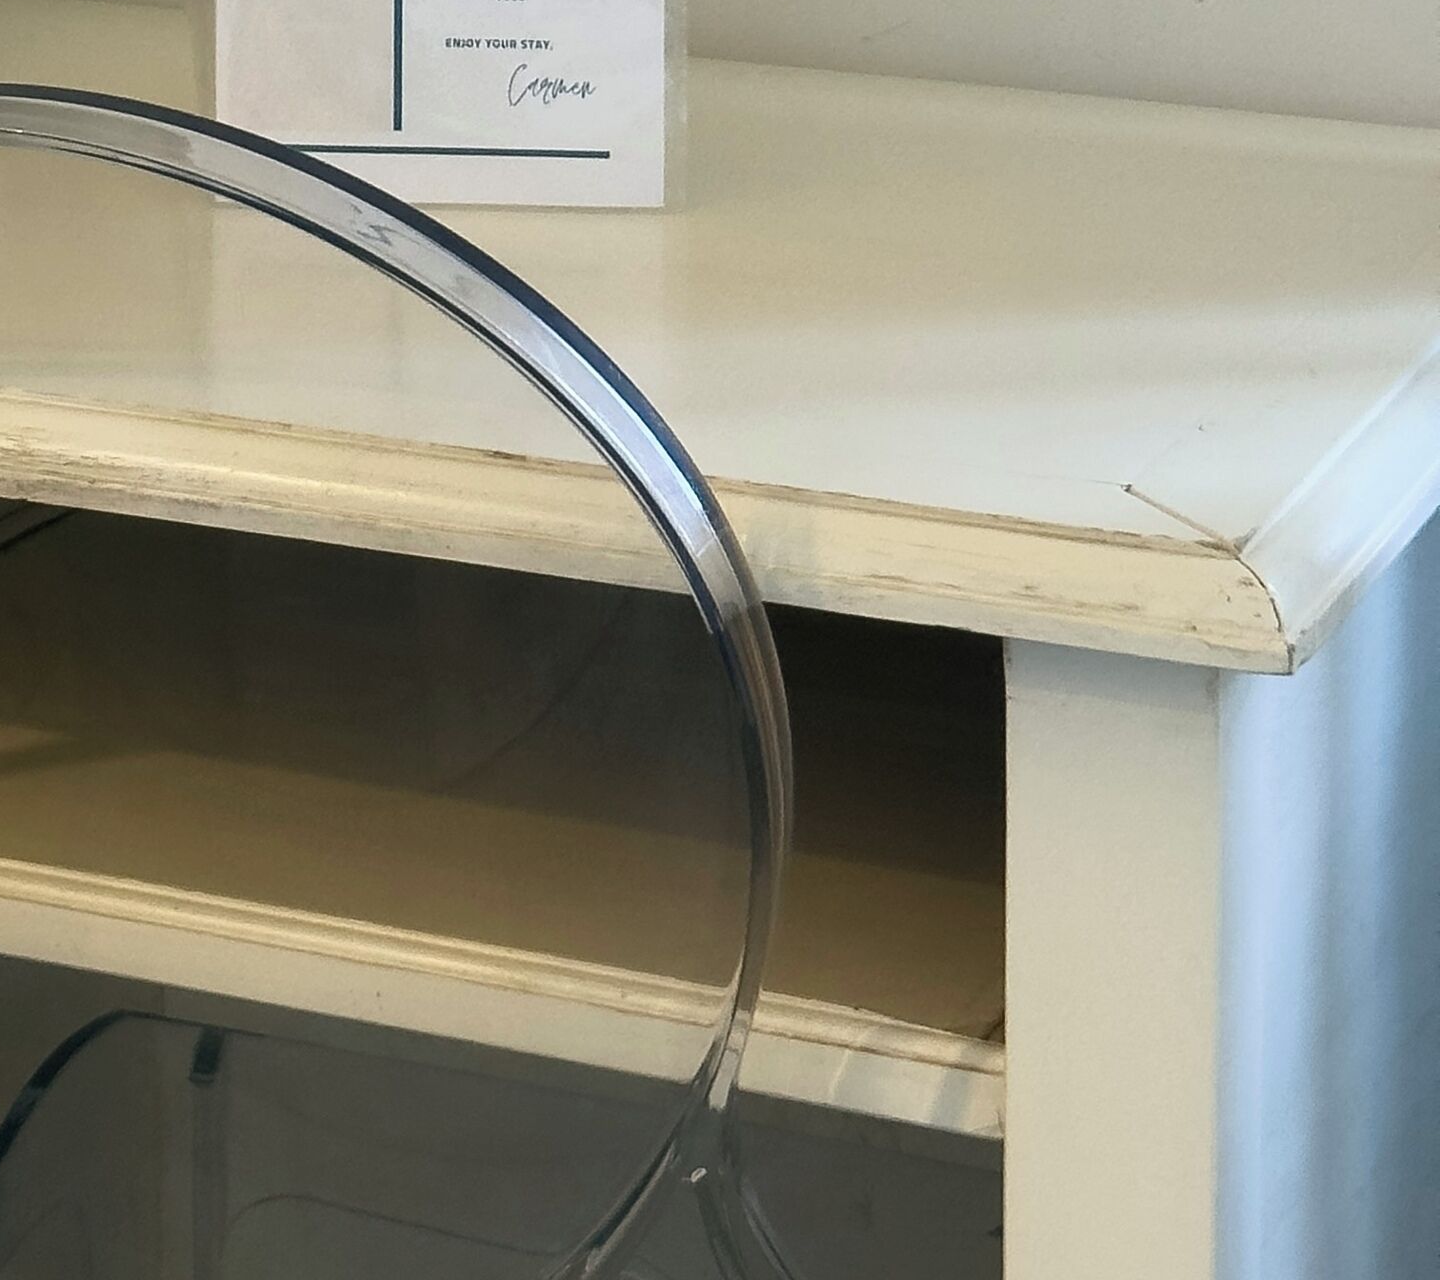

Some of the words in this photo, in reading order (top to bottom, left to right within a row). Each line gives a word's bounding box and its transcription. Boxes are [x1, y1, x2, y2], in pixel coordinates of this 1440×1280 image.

[445, 37, 481, 49] ENJOY
[484, 38, 517, 50] YOUR
[508, 63, 596, 107] Carmen
